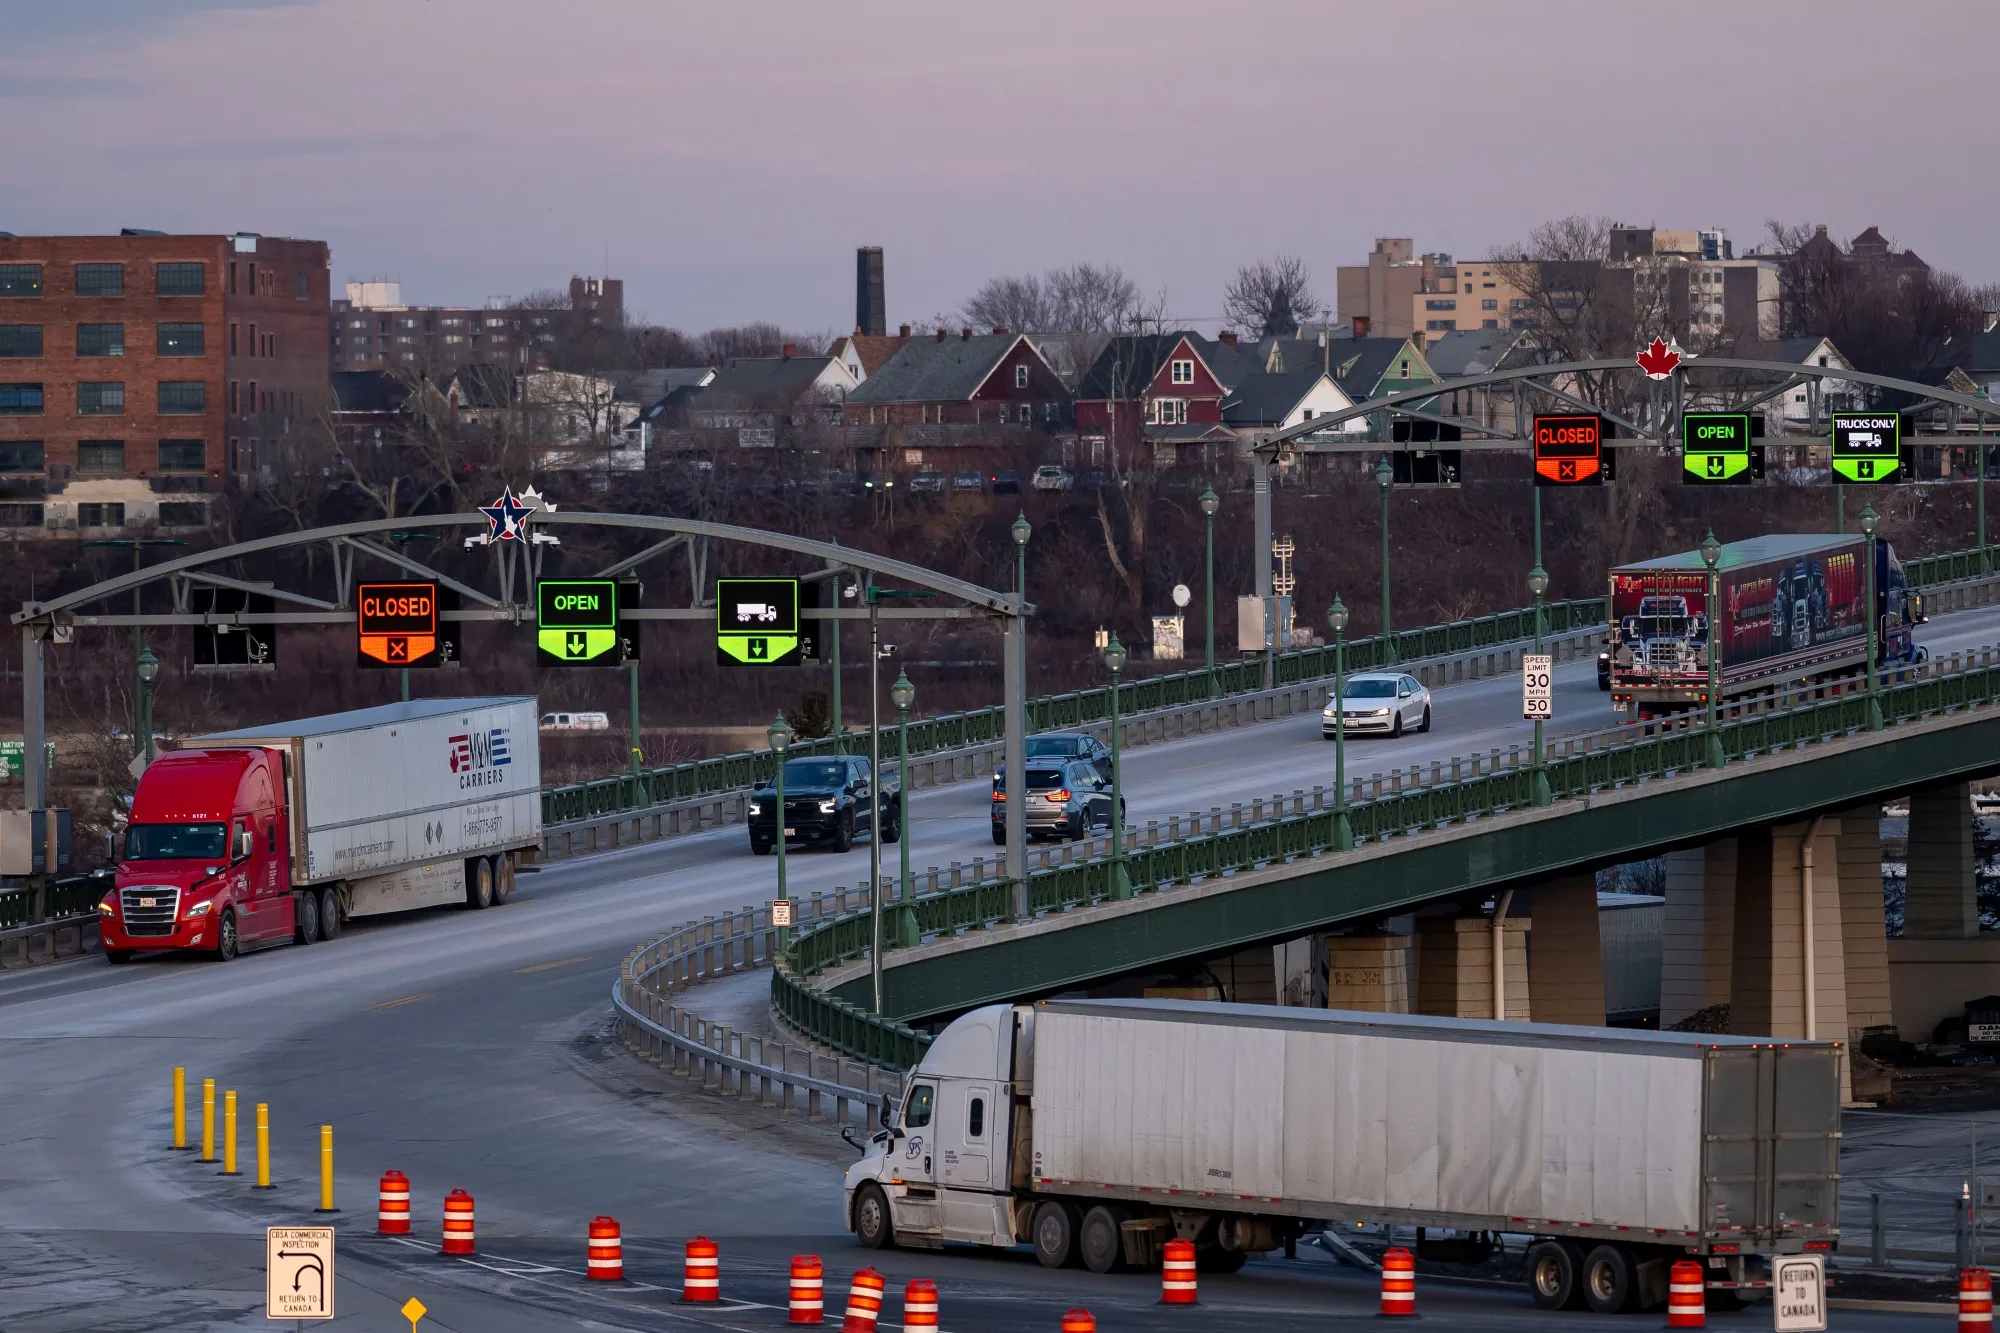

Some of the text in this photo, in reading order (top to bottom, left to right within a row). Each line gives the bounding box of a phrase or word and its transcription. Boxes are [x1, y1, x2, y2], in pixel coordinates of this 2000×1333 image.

[1835, 419, 1896, 429] TRUCKS ONLY
[1539, 427, 1595, 444] CLOSED
[1697, 426, 1735, 439] OPEN
[364, 597, 431, 617] CLOSED
[554, 595, 599, 610] OPEN
[1526, 674, 1549, 687] 30
[1528, 700, 1547, 711] 50
[460, 769, 503, 789] CARRIERS
[272, 1231, 330, 1239] CBSA COMMERCIAL
[1784, 1270, 1815, 1282] RETURN
[279, 1295, 317, 1303] RETURN TO
[1795, 1287, 1806, 1300] TO
[1781, 1304, 1816, 1317] CANADA
